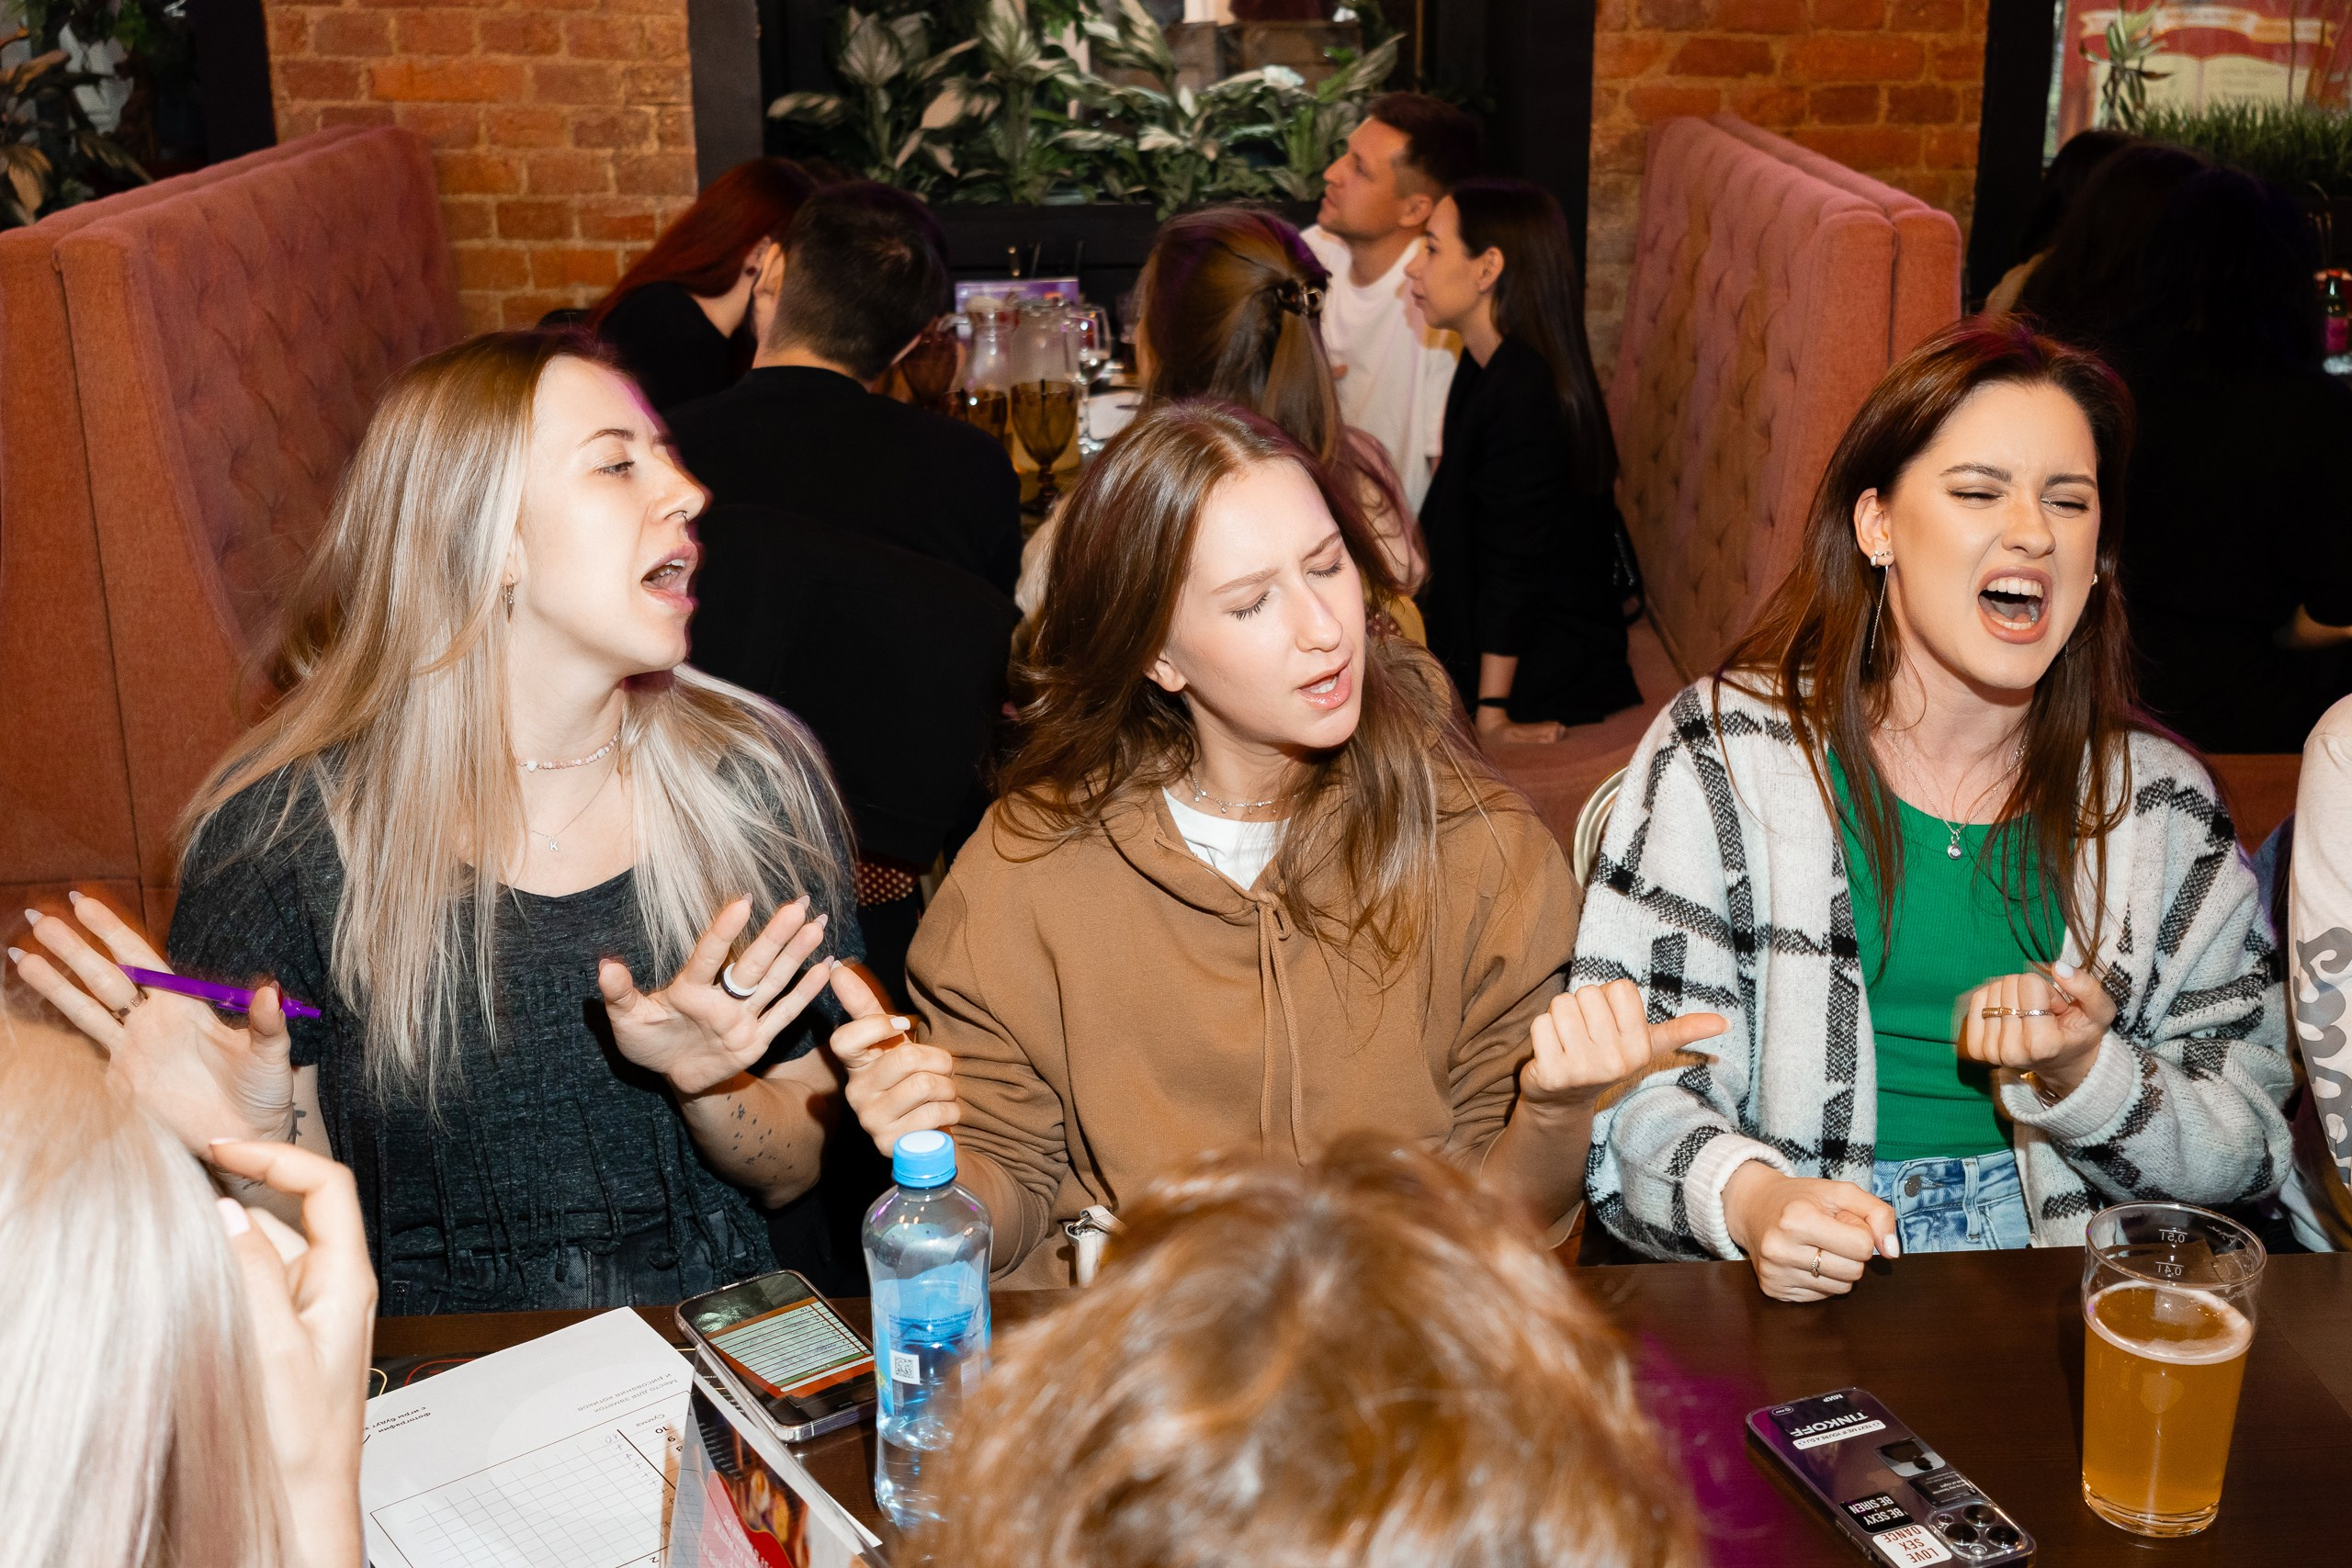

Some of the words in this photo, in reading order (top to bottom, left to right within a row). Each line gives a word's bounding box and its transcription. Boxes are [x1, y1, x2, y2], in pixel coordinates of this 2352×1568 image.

[615, 1376, 663, 1397] рисования
[649, 1378, 678, 1392] Место
[631, 1389, 648, 1399] для
[577, 1395, 614, 1412] котиков
[594, 1397, 631, 1413] заметок
[397, 1409, 420, 1419] игры
[636, 1414, 665, 1427] Сумма
[372, 1417, 397, 1428] будут
[378, 1412, 431, 1433] Фотографии
[1790, 1412, 1869, 1437] TINKOFF
[655, 1426, 669, 1434] 10
[1848, 1499, 1878, 1515] SIREN
[1877, 1495, 1894, 1506] BE
[1862, 1511, 1891, 1526] SEXY
[1887, 1507, 1905, 1518] BE
[1880, 1526, 1922, 1543] DANCE
[1899, 1538, 1925, 1551] SEX
[1905, 1547, 1939, 1563] LOVE
